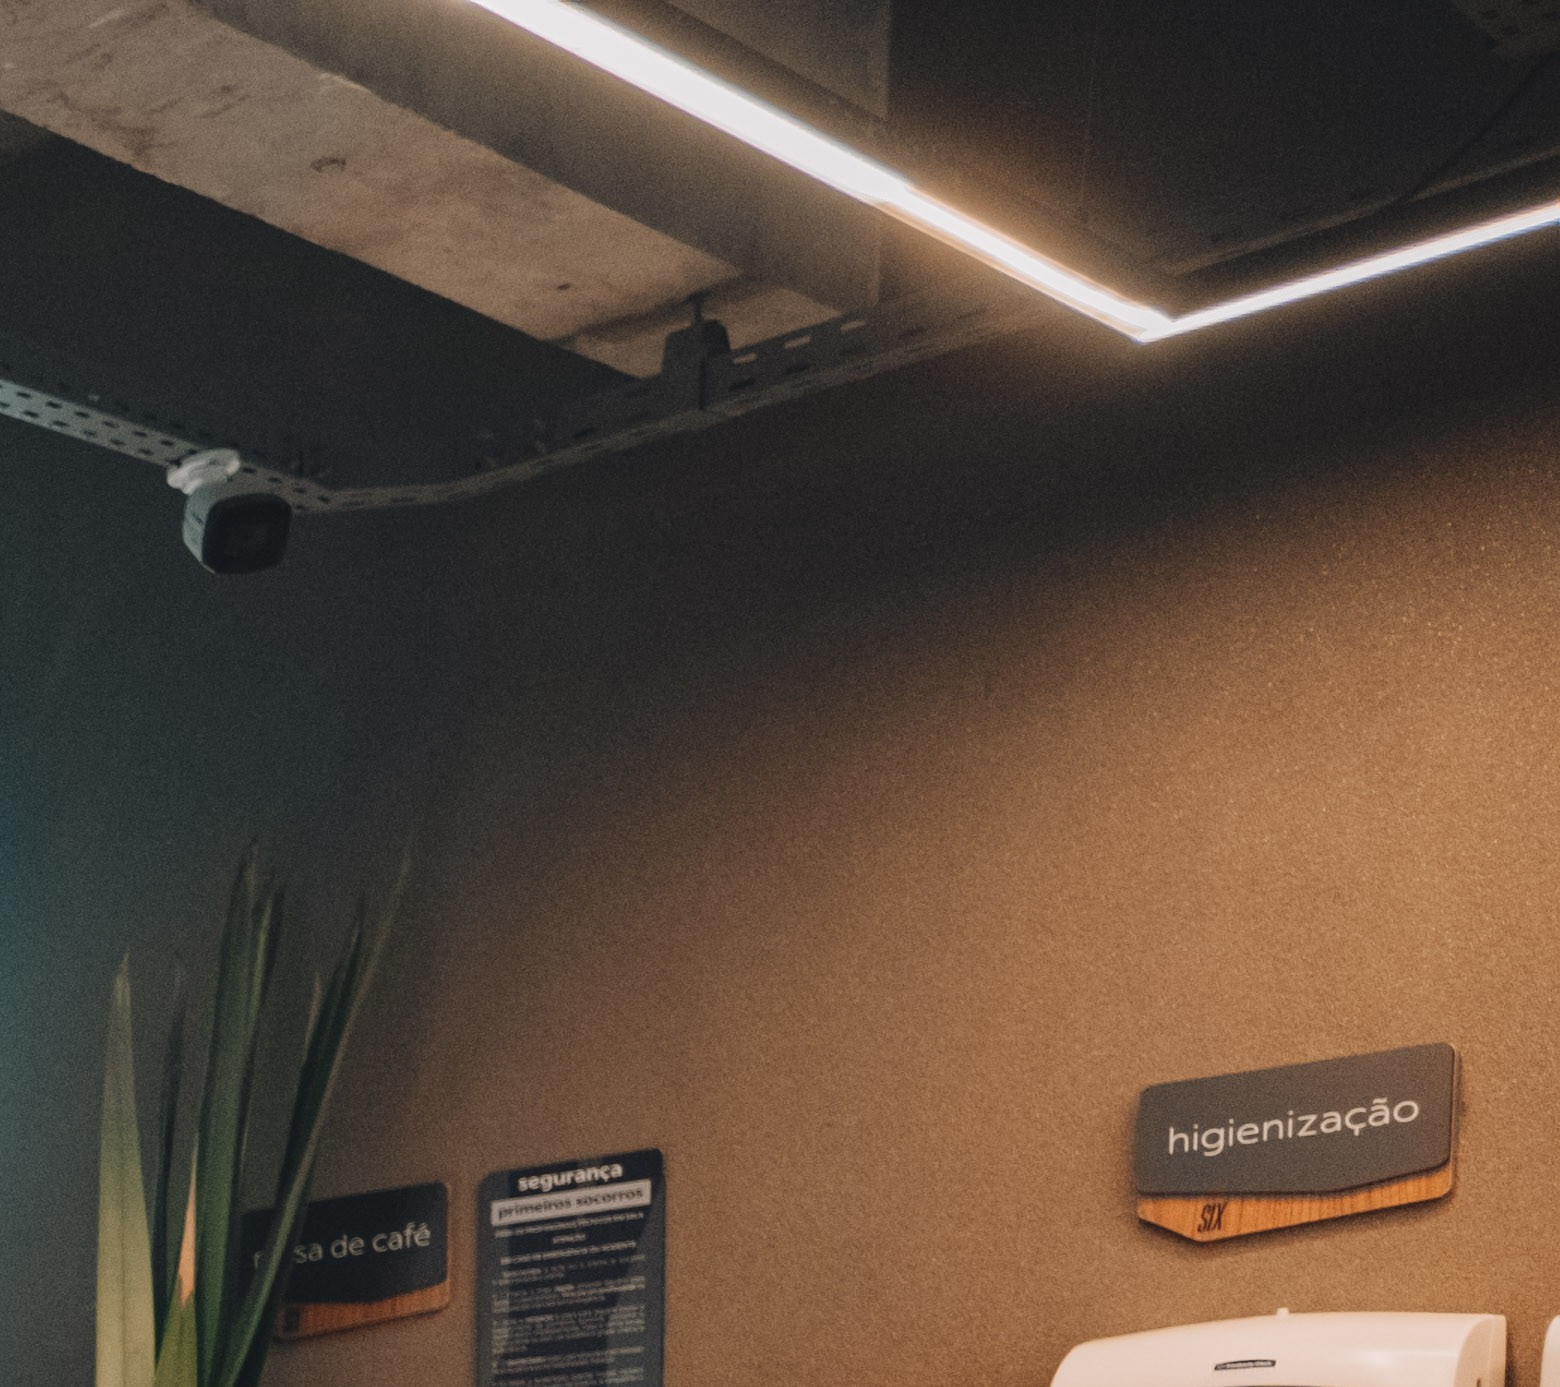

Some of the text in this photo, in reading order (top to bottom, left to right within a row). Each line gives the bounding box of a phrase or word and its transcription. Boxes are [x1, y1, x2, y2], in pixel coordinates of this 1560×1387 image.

[1169, 1097, 1420, 1157] higienização
[518, 1163, 624, 1192] segurança
[1197, 1200, 1229, 1233] SIX
[330, 1234, 365, 1260] de
[372, 1222, 432, 1254] café
